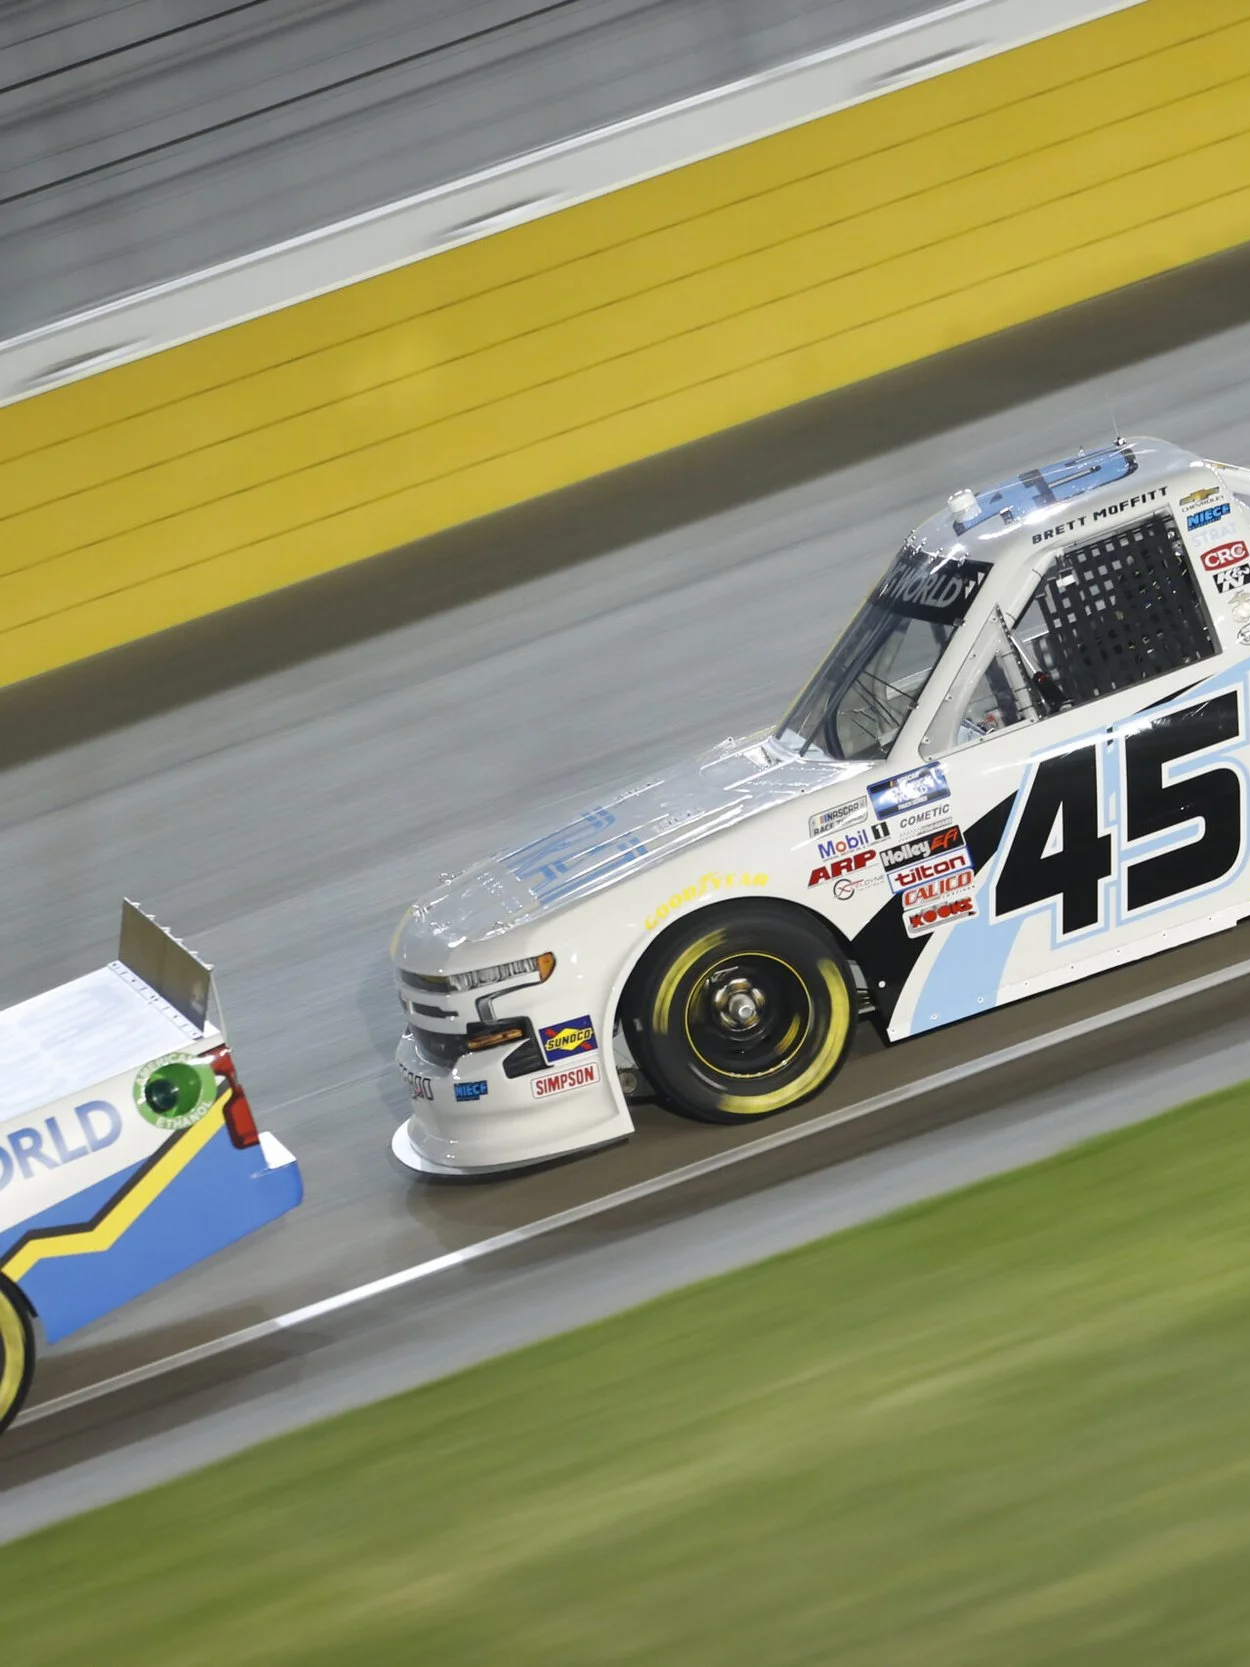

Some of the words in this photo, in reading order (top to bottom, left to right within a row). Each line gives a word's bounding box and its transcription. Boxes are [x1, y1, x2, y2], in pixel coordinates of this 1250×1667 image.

[1031, 516, 1087, 545] BRETT
[1093, 486, 1168, 521] MOFFITT
[1204, 543, 1246, 569] CRC
[889, 564, 964, 609] WORLD
[1217, 565, 1250, 593] K&N
[825, 802, 859, 824] NASCAR
[899, 803, 950, 828] COMETIC
[995, 689, 1241, 935] 45
[817, 828, 869, 859] Mobil
[881, 840, 931, 868] Holley
[808, 849, 876, 887] ARP
[895, 854, 966, 888] tilton
[644, 871, 770, 931] GOODYEAR
[904, 870, 972, 907] CALICO
[909, 897, 973, 928] KOOKS
[545, 1028, 594, 1052] SUNOCO
[535, 1066, 596, 1096] SIMPSON
[0, 1100, 122, 1191] RLD
